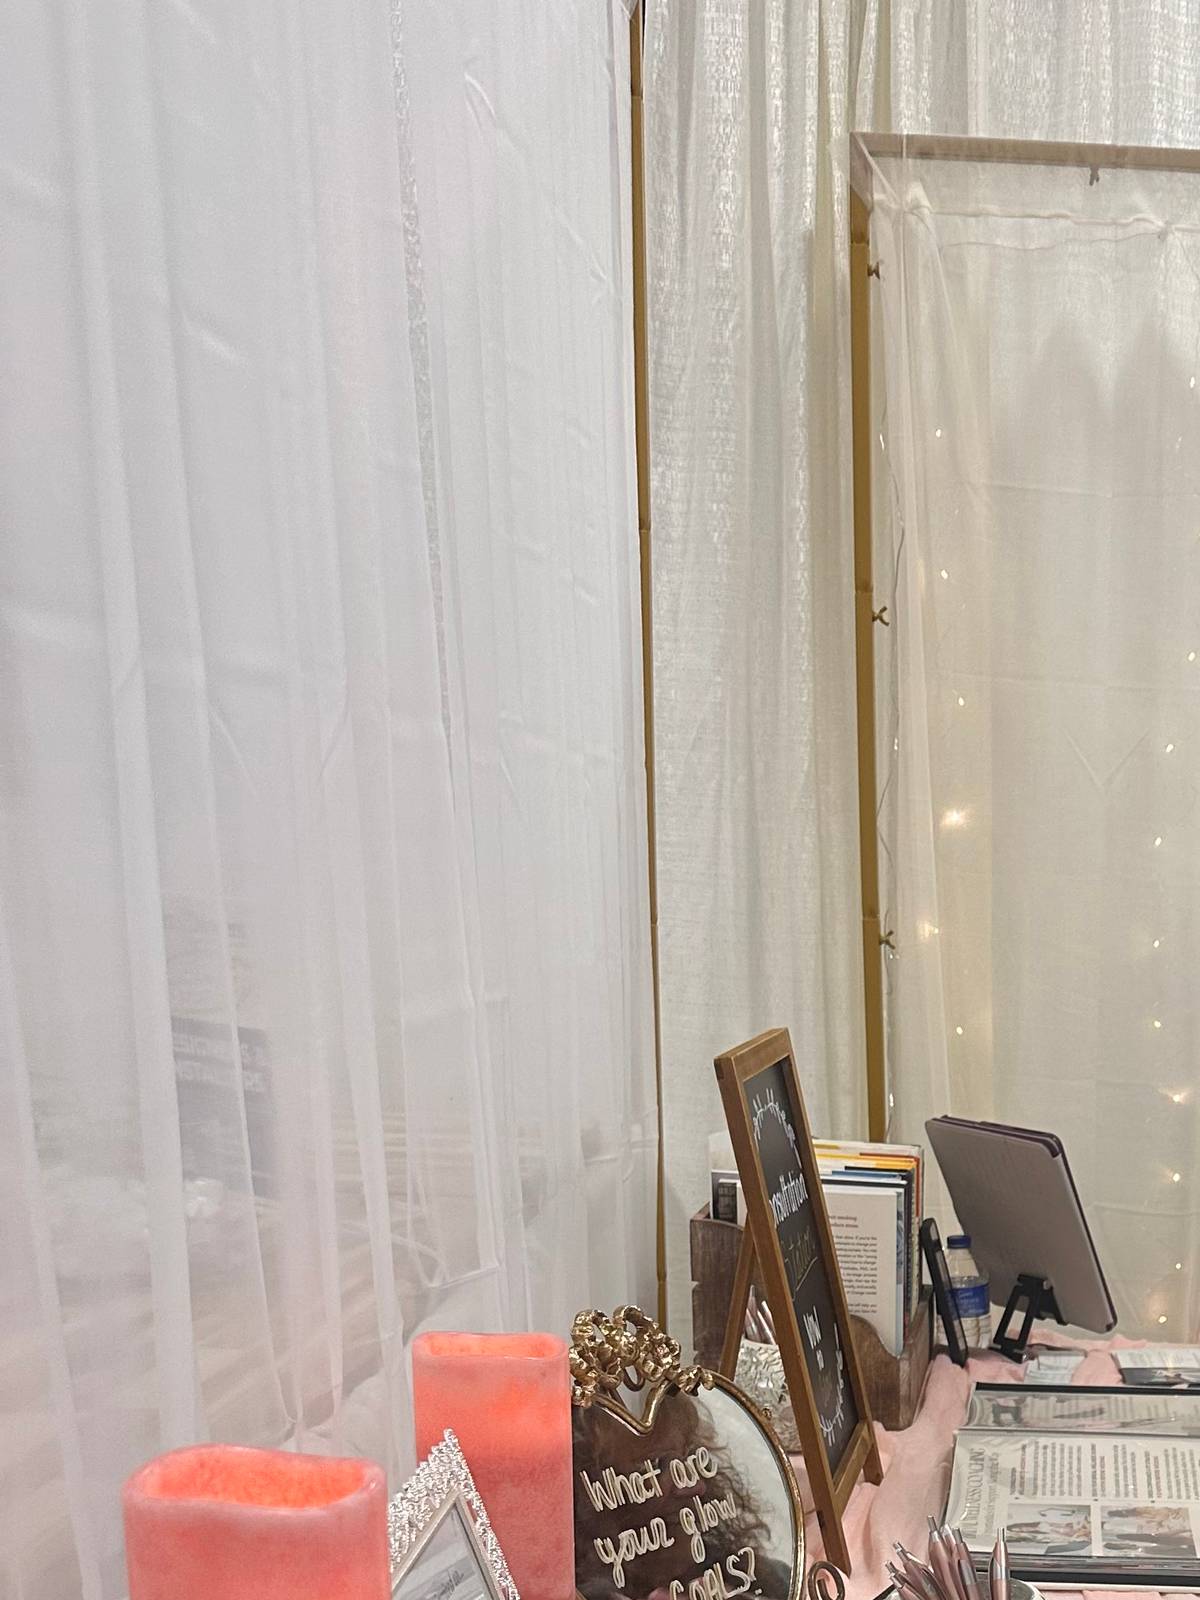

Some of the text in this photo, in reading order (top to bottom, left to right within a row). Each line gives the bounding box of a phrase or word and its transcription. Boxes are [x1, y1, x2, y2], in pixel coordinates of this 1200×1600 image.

[580, 1447, 717, 1512] What are
[594, 1493, 737, 1588] your glow
